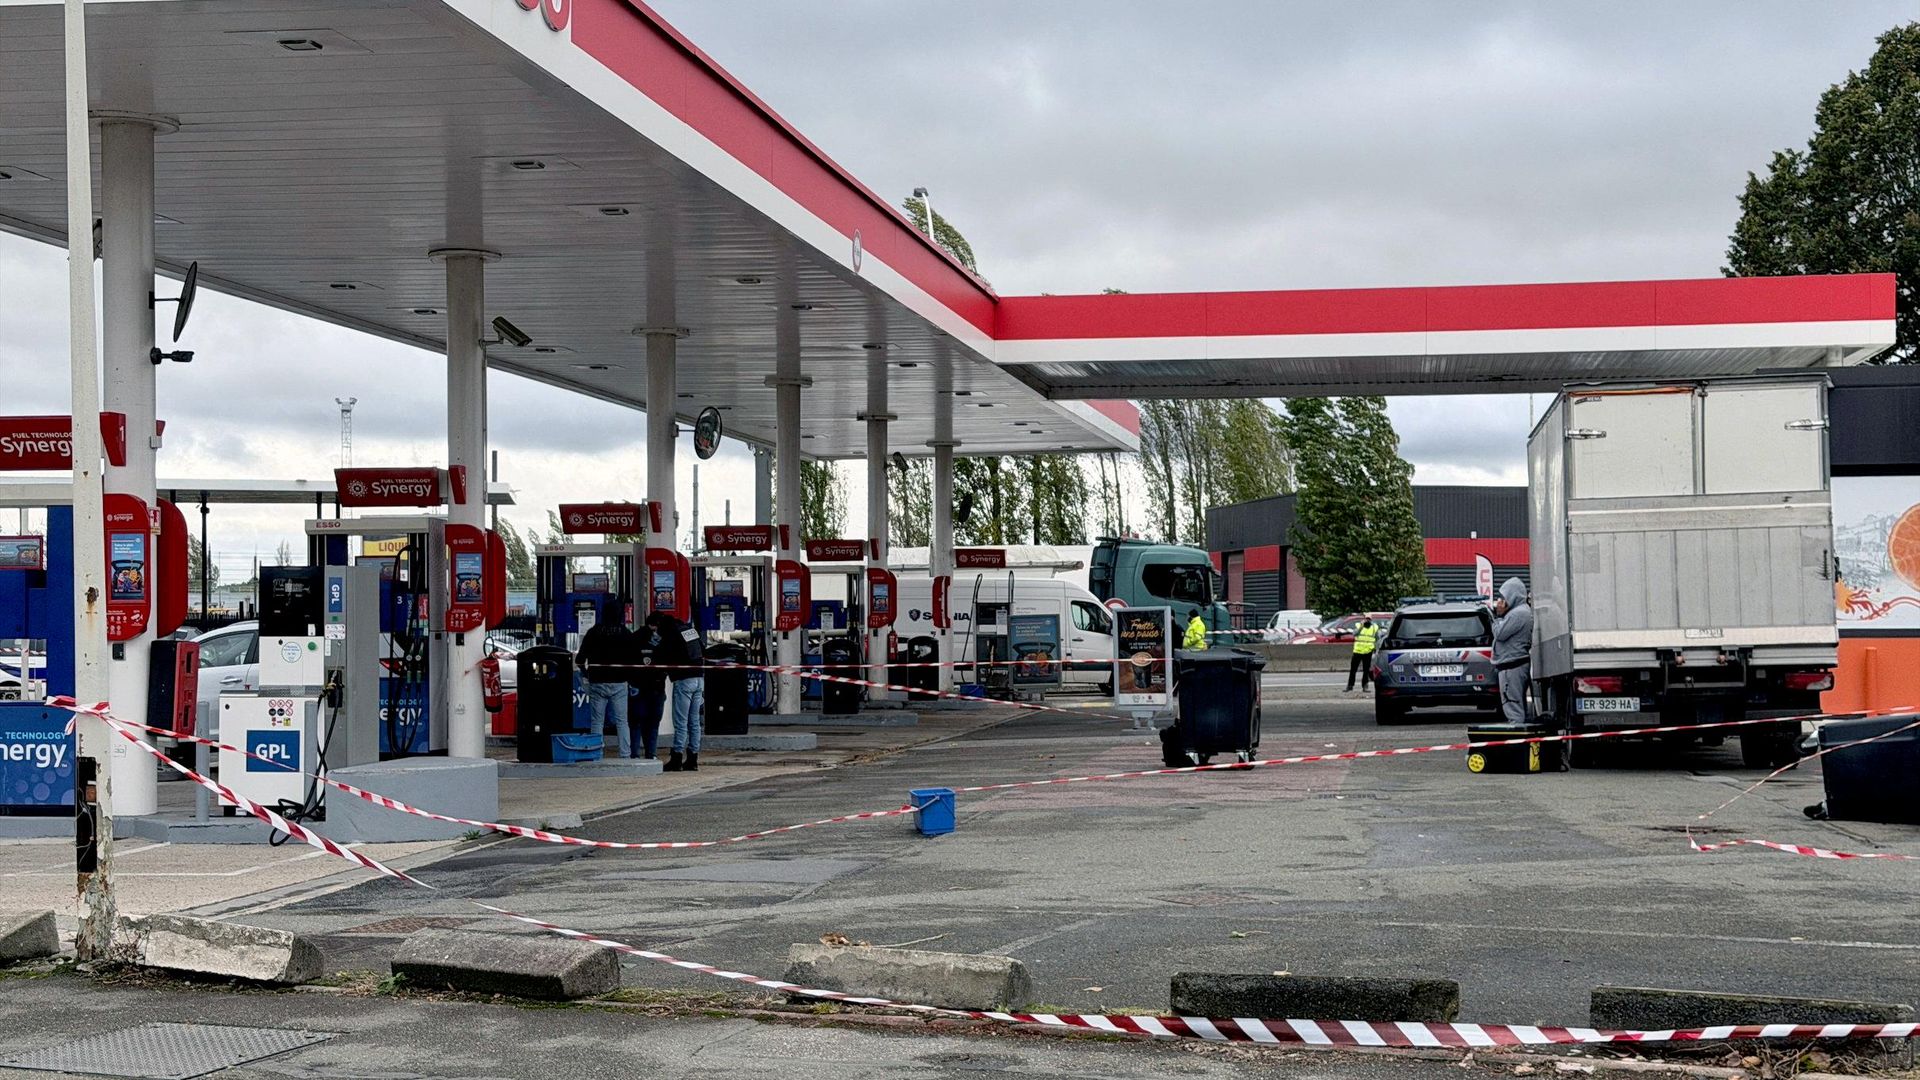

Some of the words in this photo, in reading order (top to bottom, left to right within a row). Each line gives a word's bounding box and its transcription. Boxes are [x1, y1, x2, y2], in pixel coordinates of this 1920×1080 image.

[119, 425, 125, 442] 1
[0, 436, 73, 457] Synerg
[371, 482, 432, 497] Synergy
[315, 521, 341, 529] ESSO
[587, 514, 635, 527] Synergy
[727, 534, 767, 545] Synergy
[825, 547, 860, 557] Synergy
[970, 555, 1001, 564] Synergy
[331, 583, 341, 605] GPL
[396, 595, 403, 605] 3
[1409, 650, 1453, 659] POLICE
[5, 731, 66, 740] TECHNOLOGY
[255, 743, 291, 760] GPL
